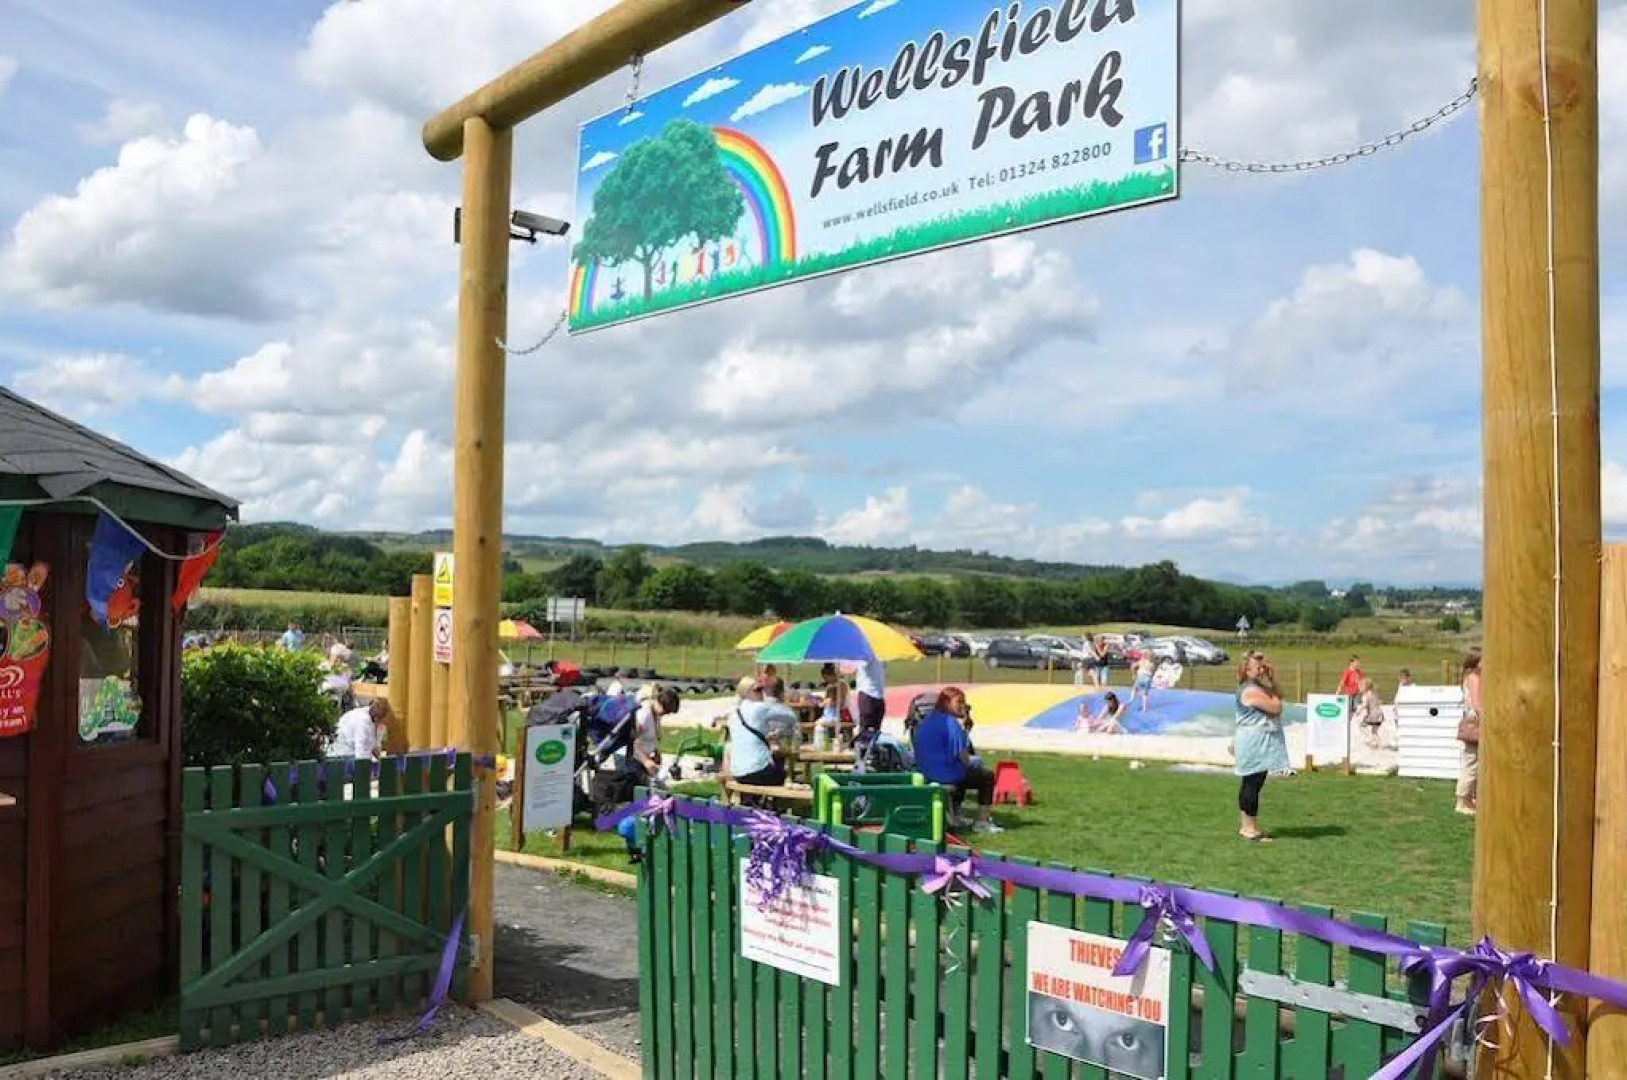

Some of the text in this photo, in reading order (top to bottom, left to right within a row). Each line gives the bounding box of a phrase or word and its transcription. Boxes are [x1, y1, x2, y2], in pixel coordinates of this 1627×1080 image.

[810, 50, 1124, 198] Farm Park
[822, 142, 1111, 229] www.wellsfield.co.uk Tel: 01324 822800
[0, 688, 22, 699] LL'S
[1031, 970, 1162, 1022] WE ARE WATCHING YOU
